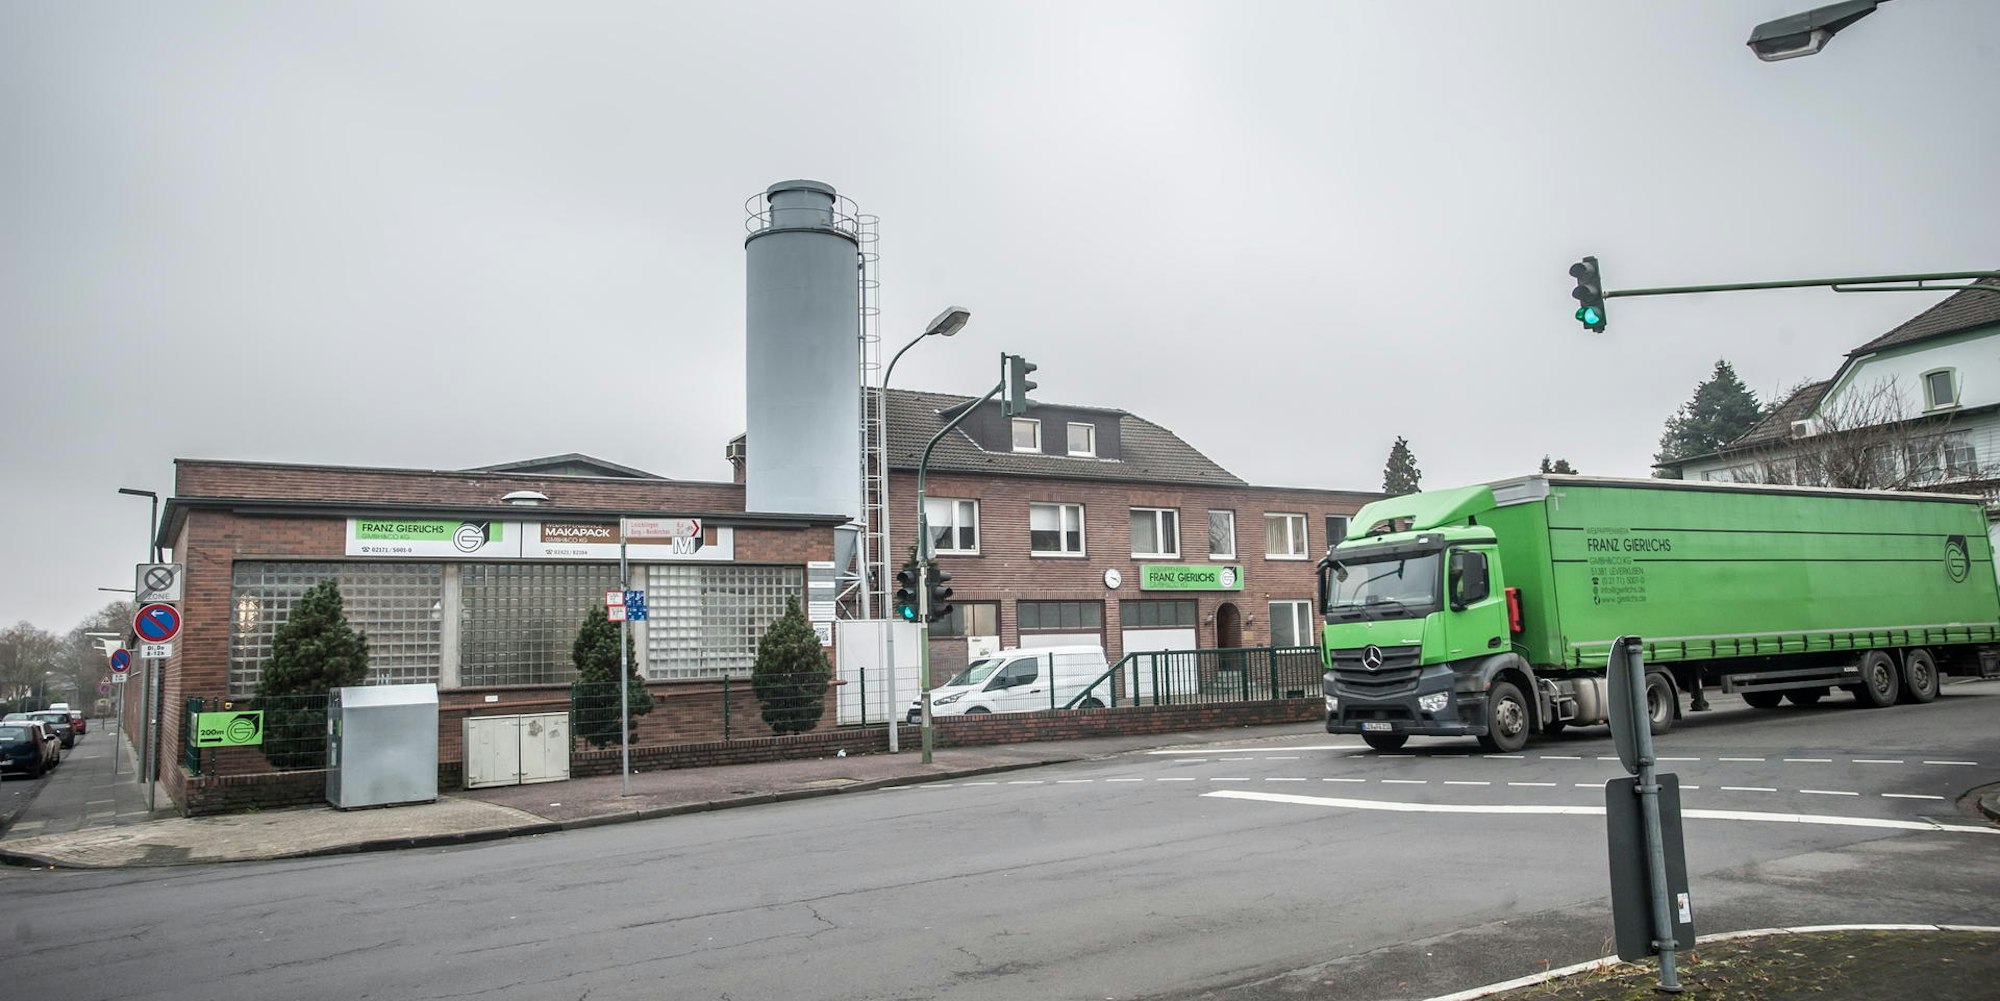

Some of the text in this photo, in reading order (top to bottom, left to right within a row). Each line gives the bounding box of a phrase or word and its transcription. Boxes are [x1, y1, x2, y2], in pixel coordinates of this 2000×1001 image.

[361, 523, 445, 534] FRANZ GIERLICHS
[545, 527, 611, 538] MAKAPACK
[1587, 538, 1672, 552] FRANZ GIERLICHS
[1609, 567, 1644, 575] LEVERKUSEN
[1149, 572, 1216, 583] FRANZ GIERLICHS
[200, 728, 225, 736] 200m
